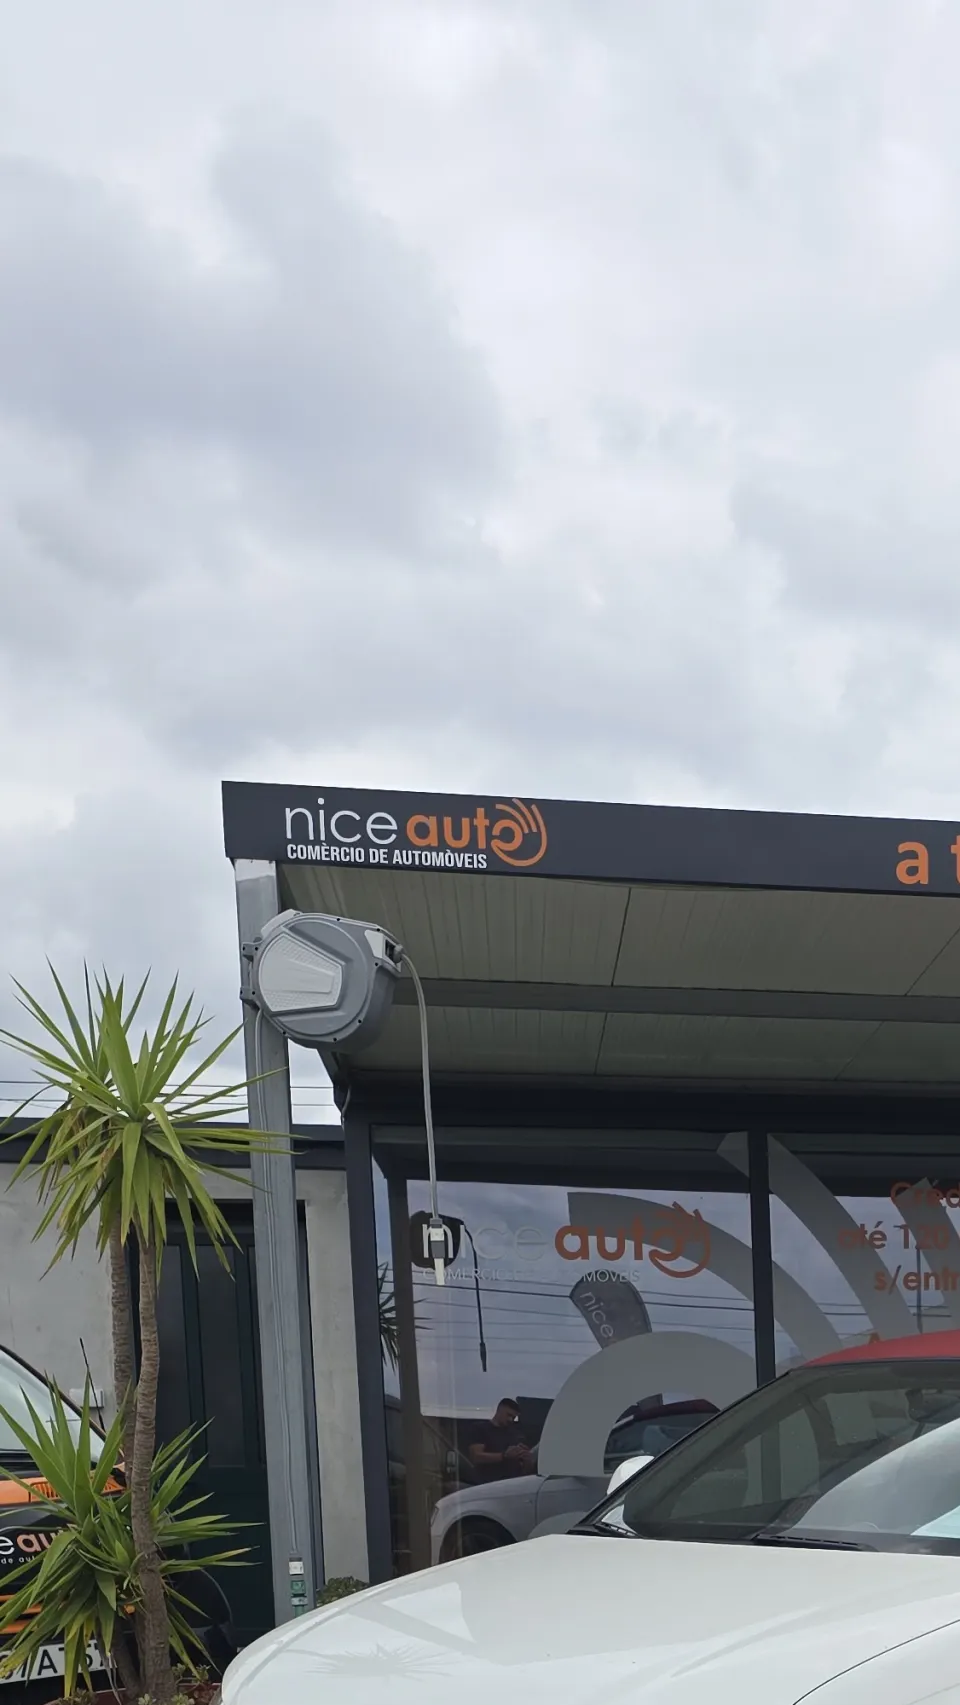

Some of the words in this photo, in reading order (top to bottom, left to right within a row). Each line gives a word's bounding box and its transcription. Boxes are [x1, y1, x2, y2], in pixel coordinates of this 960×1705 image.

[369, 849, 389, 865] DE
[895, 840, 930, 884] a
[837, 1220, 888, 1250] até
[893, 1224, 950, 1250] 120
